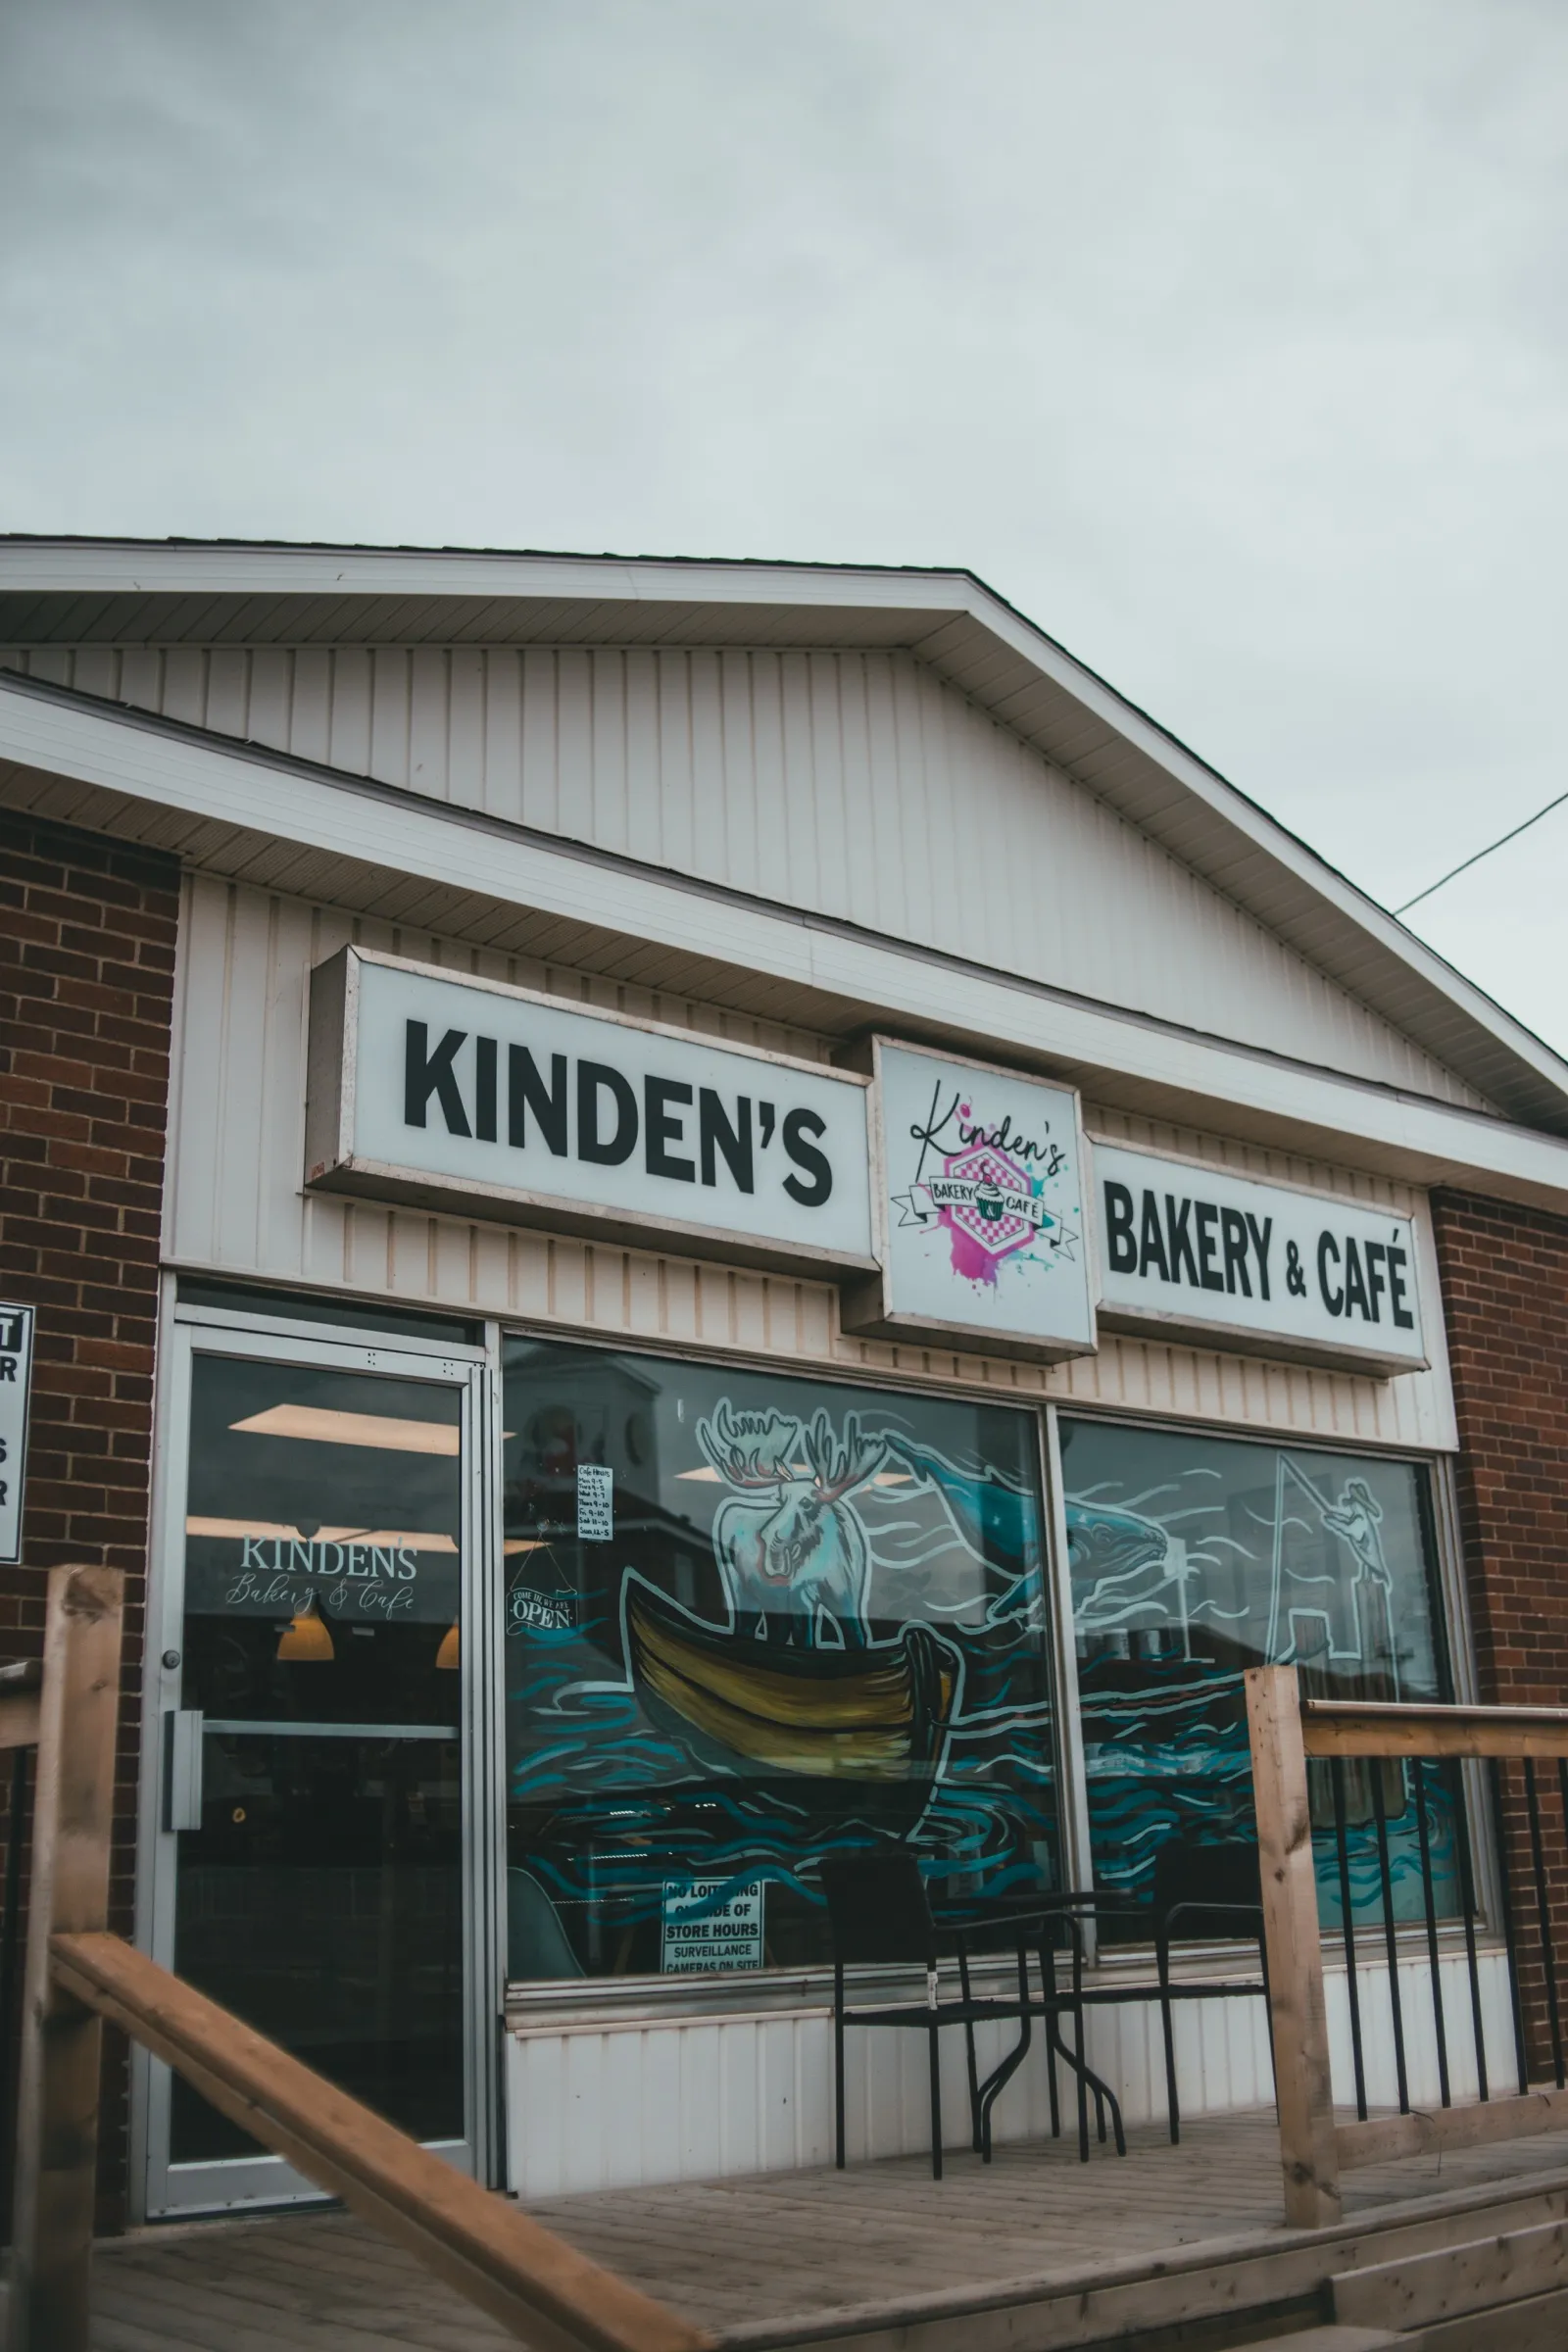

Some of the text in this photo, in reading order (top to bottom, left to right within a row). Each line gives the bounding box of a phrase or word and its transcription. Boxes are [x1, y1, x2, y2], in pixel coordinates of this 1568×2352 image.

[404, 1018, 833, 1207] KINDEN'S
[909, 1079, 1067, 1184] Kinden's
[932, 1183, 974, 1200] BAKERY
[1005, 1196, 1040, 1219] CAFÉ
[1103, 1180, 1414, 1330] BAKERY & CAFÉ
[240, 1534, 417, 1580] KINDEN'S
[328, 1578, 348, 1612] &
[514, 1592, 532, 1600] COME
[544, 1598, 553, 1607] WE
[513, 1599, 570, 1629] OPEN
[734, 1903, 752, 1917] OF
[666, 1923, 759, 1938] STORE HOURS
[666, 1960, 759, 1973] CAMERAS ON SITE
[674, 1944, 752, 1958] SURVEILLANCE
